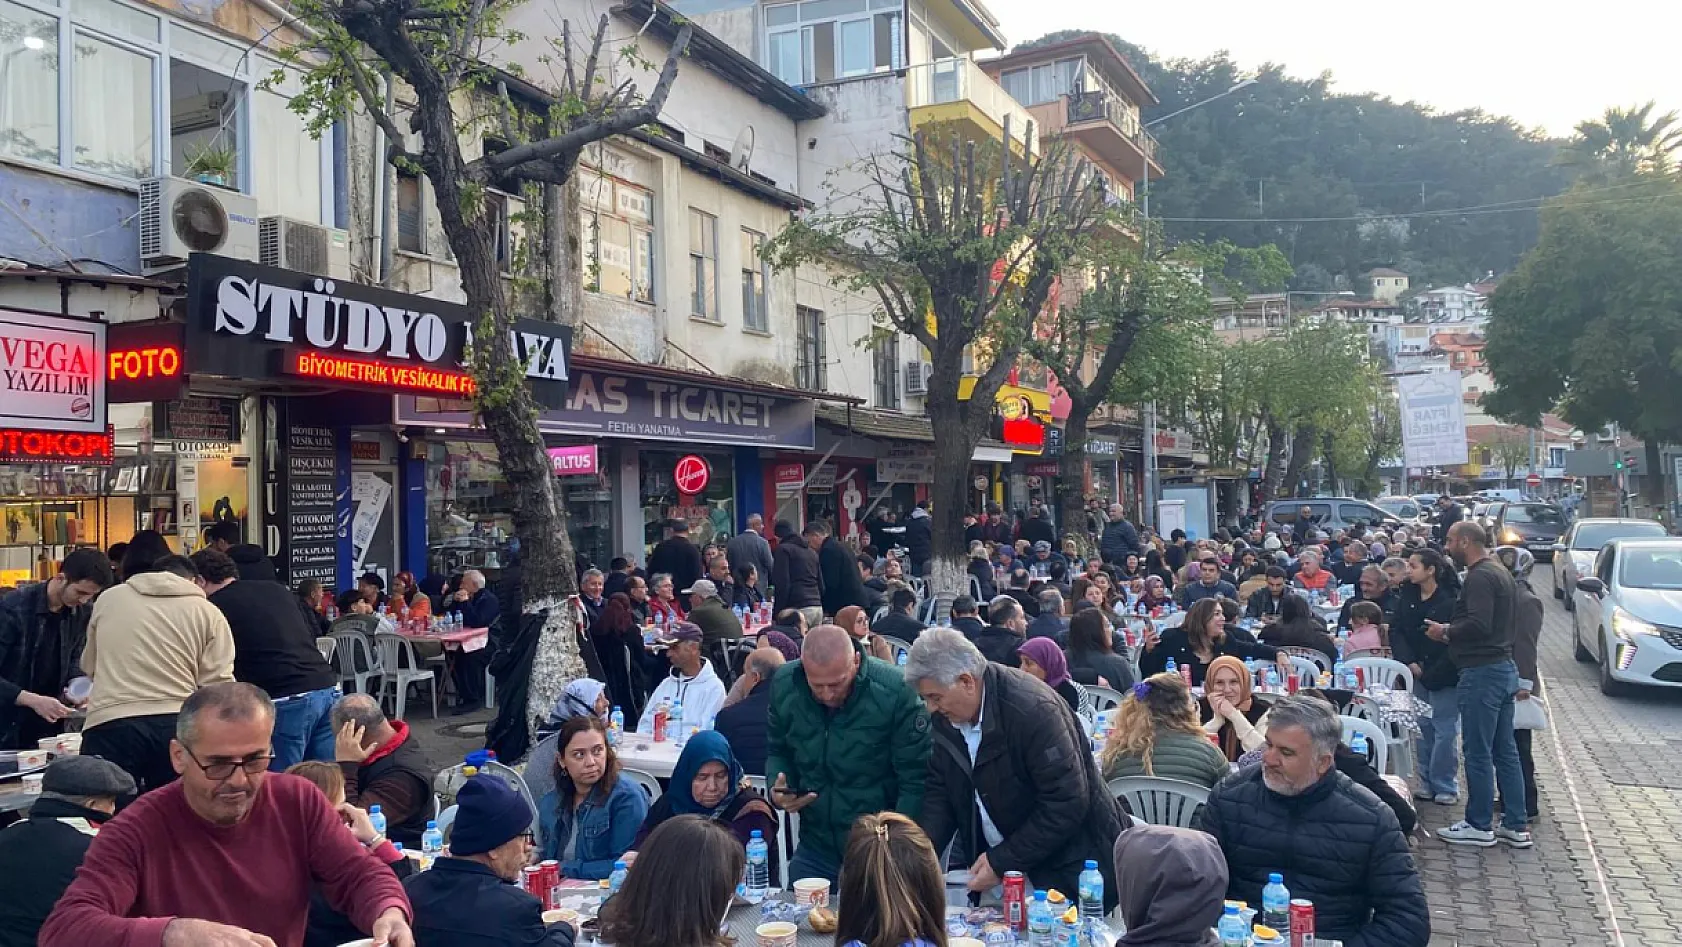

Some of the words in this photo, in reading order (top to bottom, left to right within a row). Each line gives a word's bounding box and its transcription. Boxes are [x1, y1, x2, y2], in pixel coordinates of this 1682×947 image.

[215, 275, 447, 362] STÜDYO
[0, 336, 88, 374] VEGA
[110, 347, 178, 380] FOTO
[4, 369, 88, 395] YAZILIM
[299, 352, 388, 382] BİYOMETRİK
[391, 366, 457, 392] VESİKALIK
[647, 382, 775, 428] TİCARET
[638, 423, 682, 436] YANATMA
[553, 454, 591, 469] ALTUS
[292, 512, 334, 524] FOTOKOPİ
